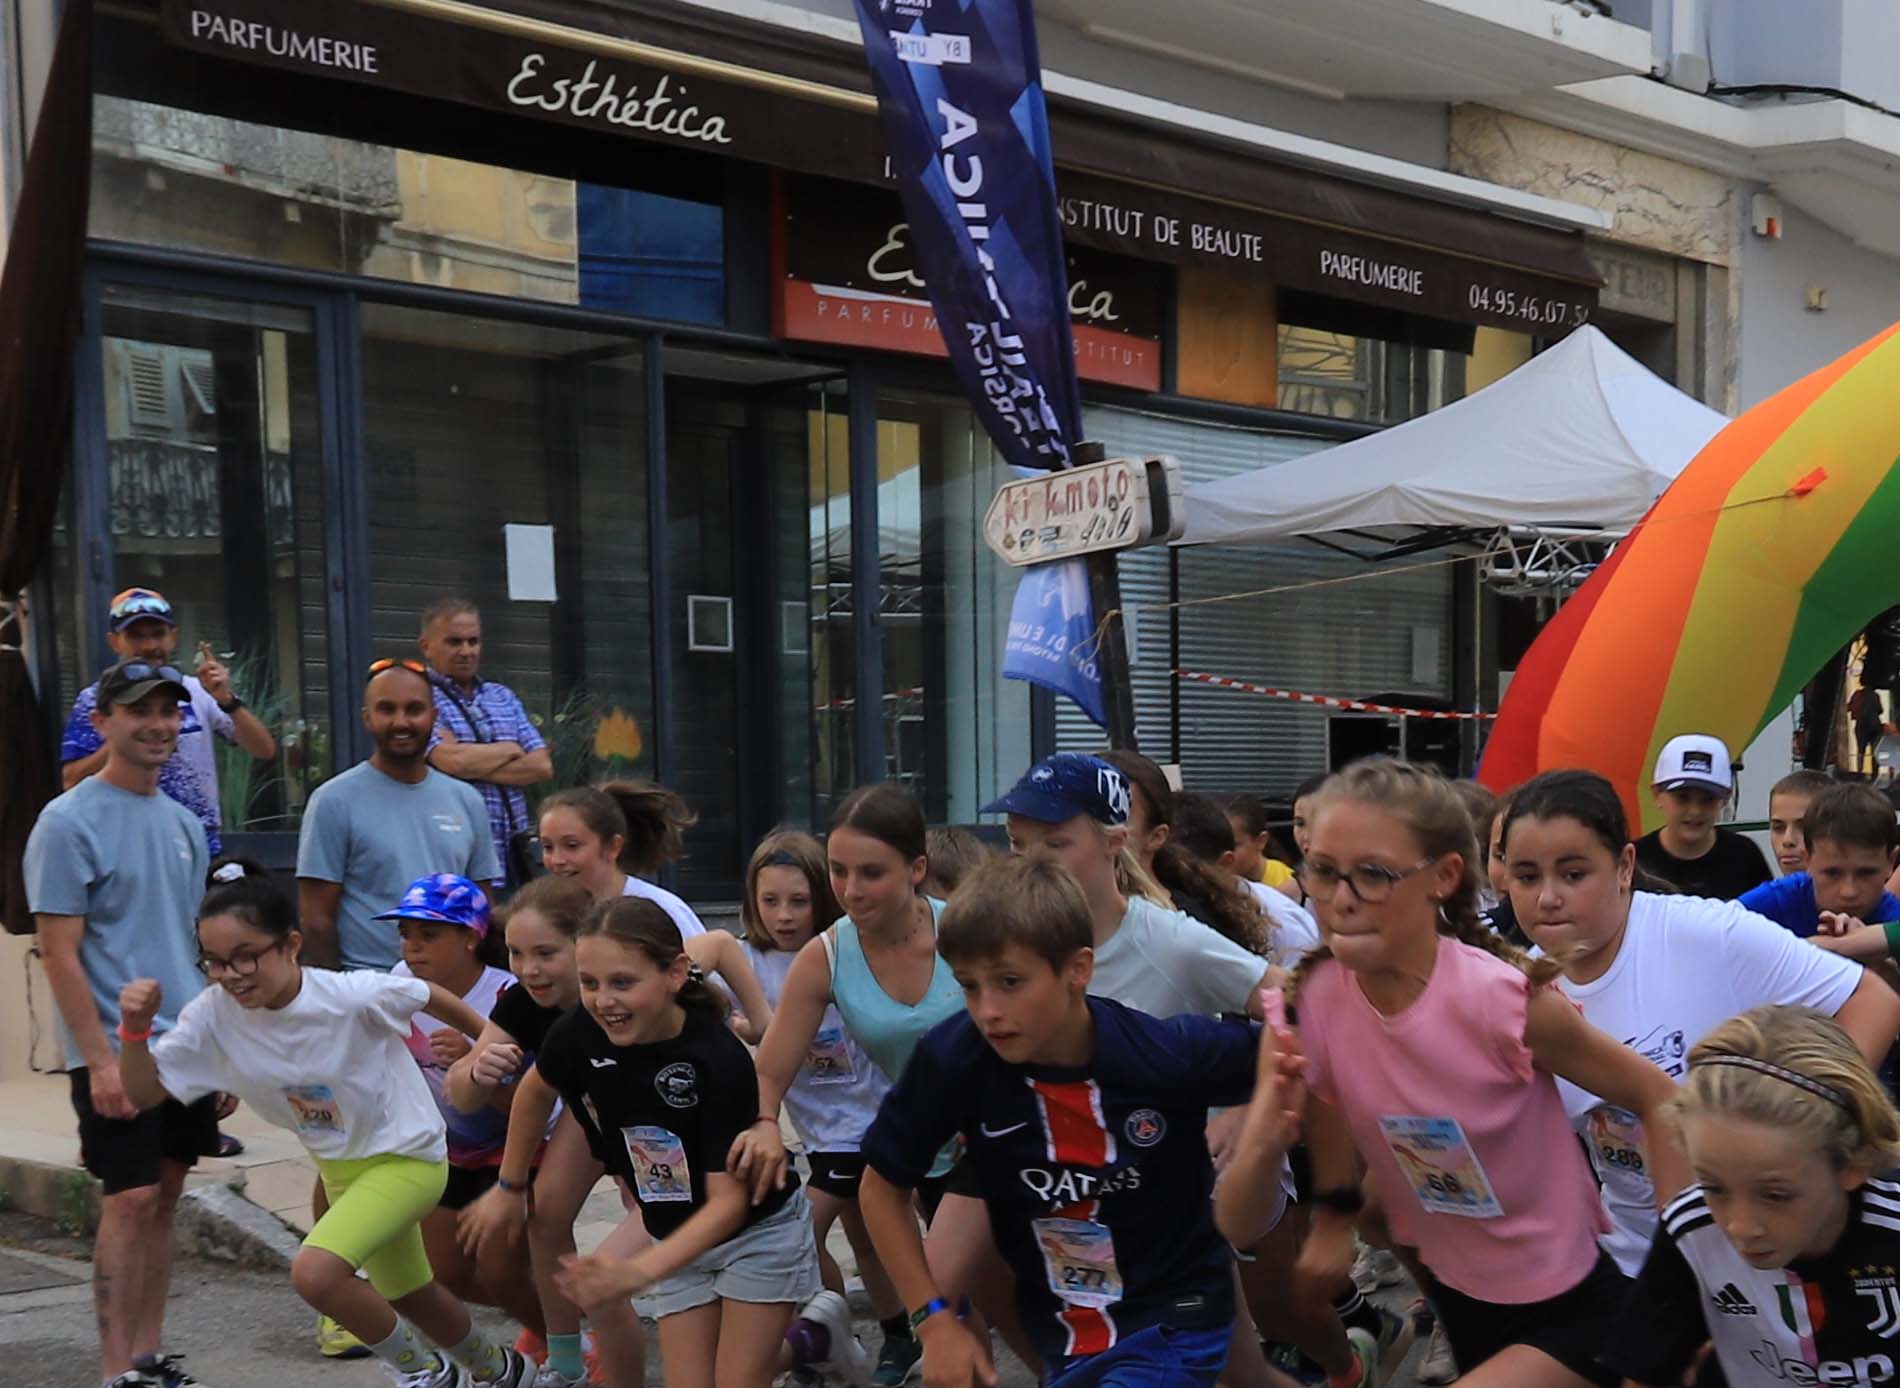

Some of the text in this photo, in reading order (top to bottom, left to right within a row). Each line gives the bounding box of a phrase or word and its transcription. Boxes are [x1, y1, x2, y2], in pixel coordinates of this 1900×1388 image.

[192, 10, 378, 73] PARFUMERIE
[507, 54, 732, 142] Esthética
[1154, 216, 1180, 246] DE
[1192, 224, 1263, 261] BEAUTE
[1321, 250, 1423, 295] PARFUMERIE
[650, 1163, 672, 1179] 43
